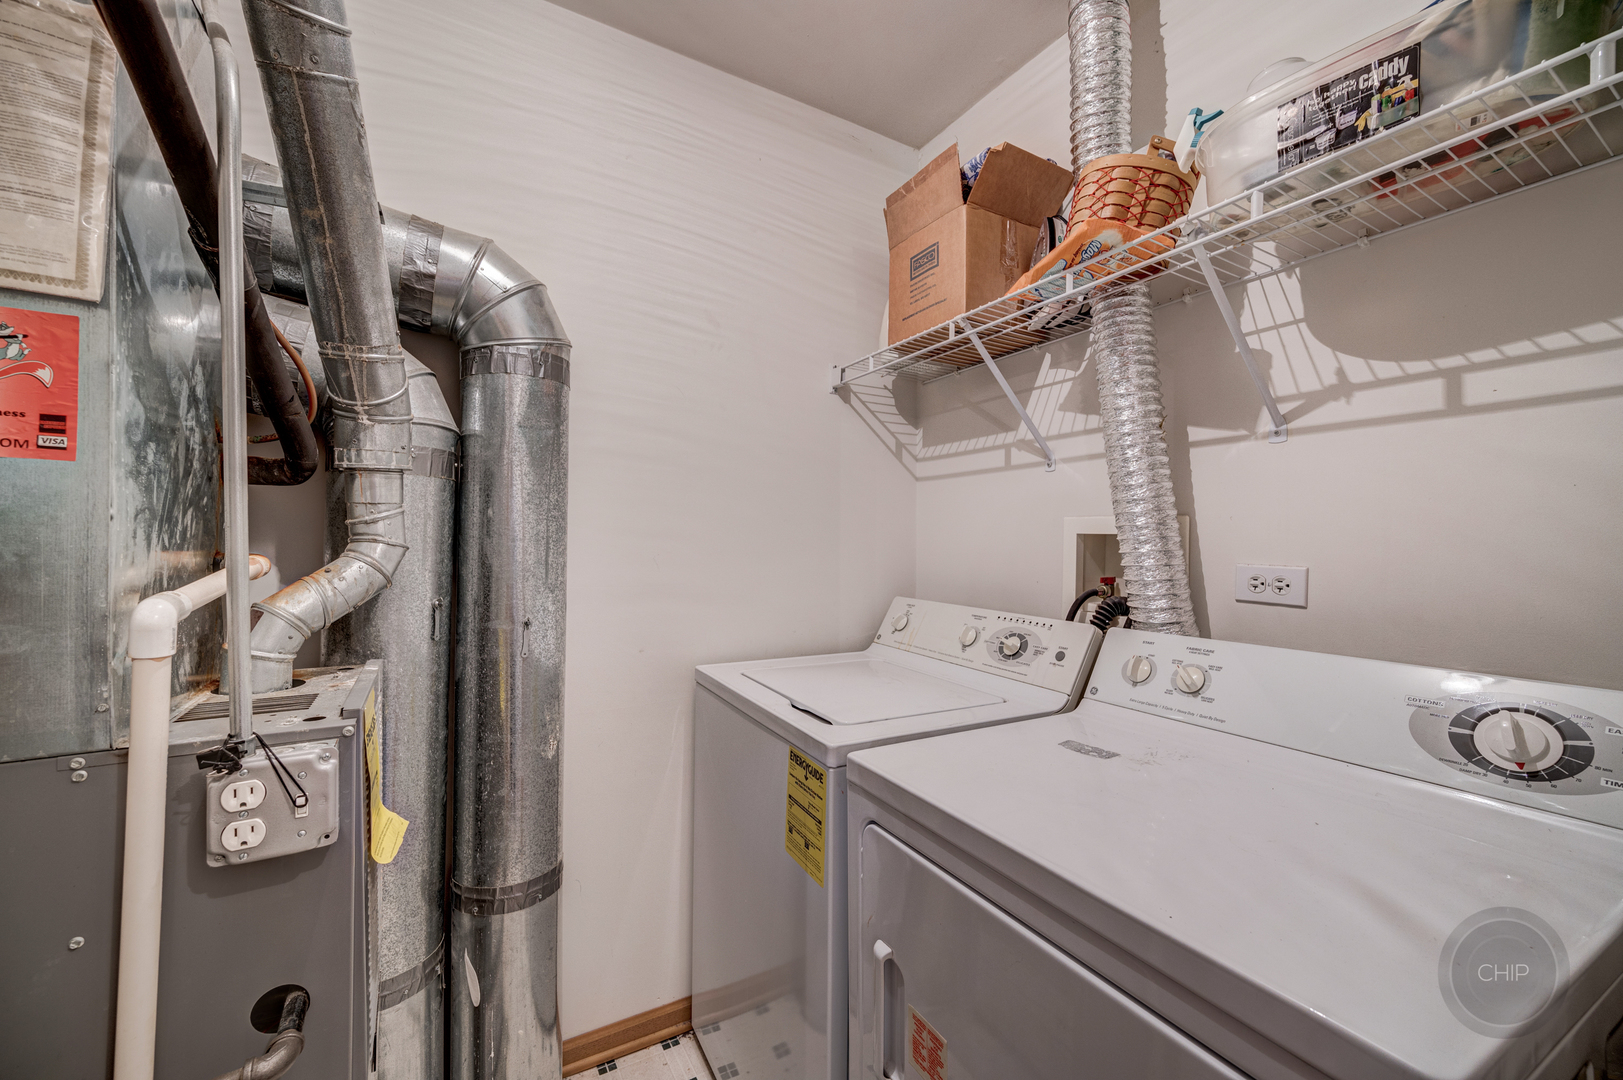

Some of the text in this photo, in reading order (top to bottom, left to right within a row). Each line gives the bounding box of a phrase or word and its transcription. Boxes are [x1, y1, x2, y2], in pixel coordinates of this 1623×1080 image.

[1359, 55, 1410, 90] caddy
[1323, 78, 1355, 98] happy
[41, 437, 65, 445] VISA
[1407, 697, 1443, 706] COTTONS
